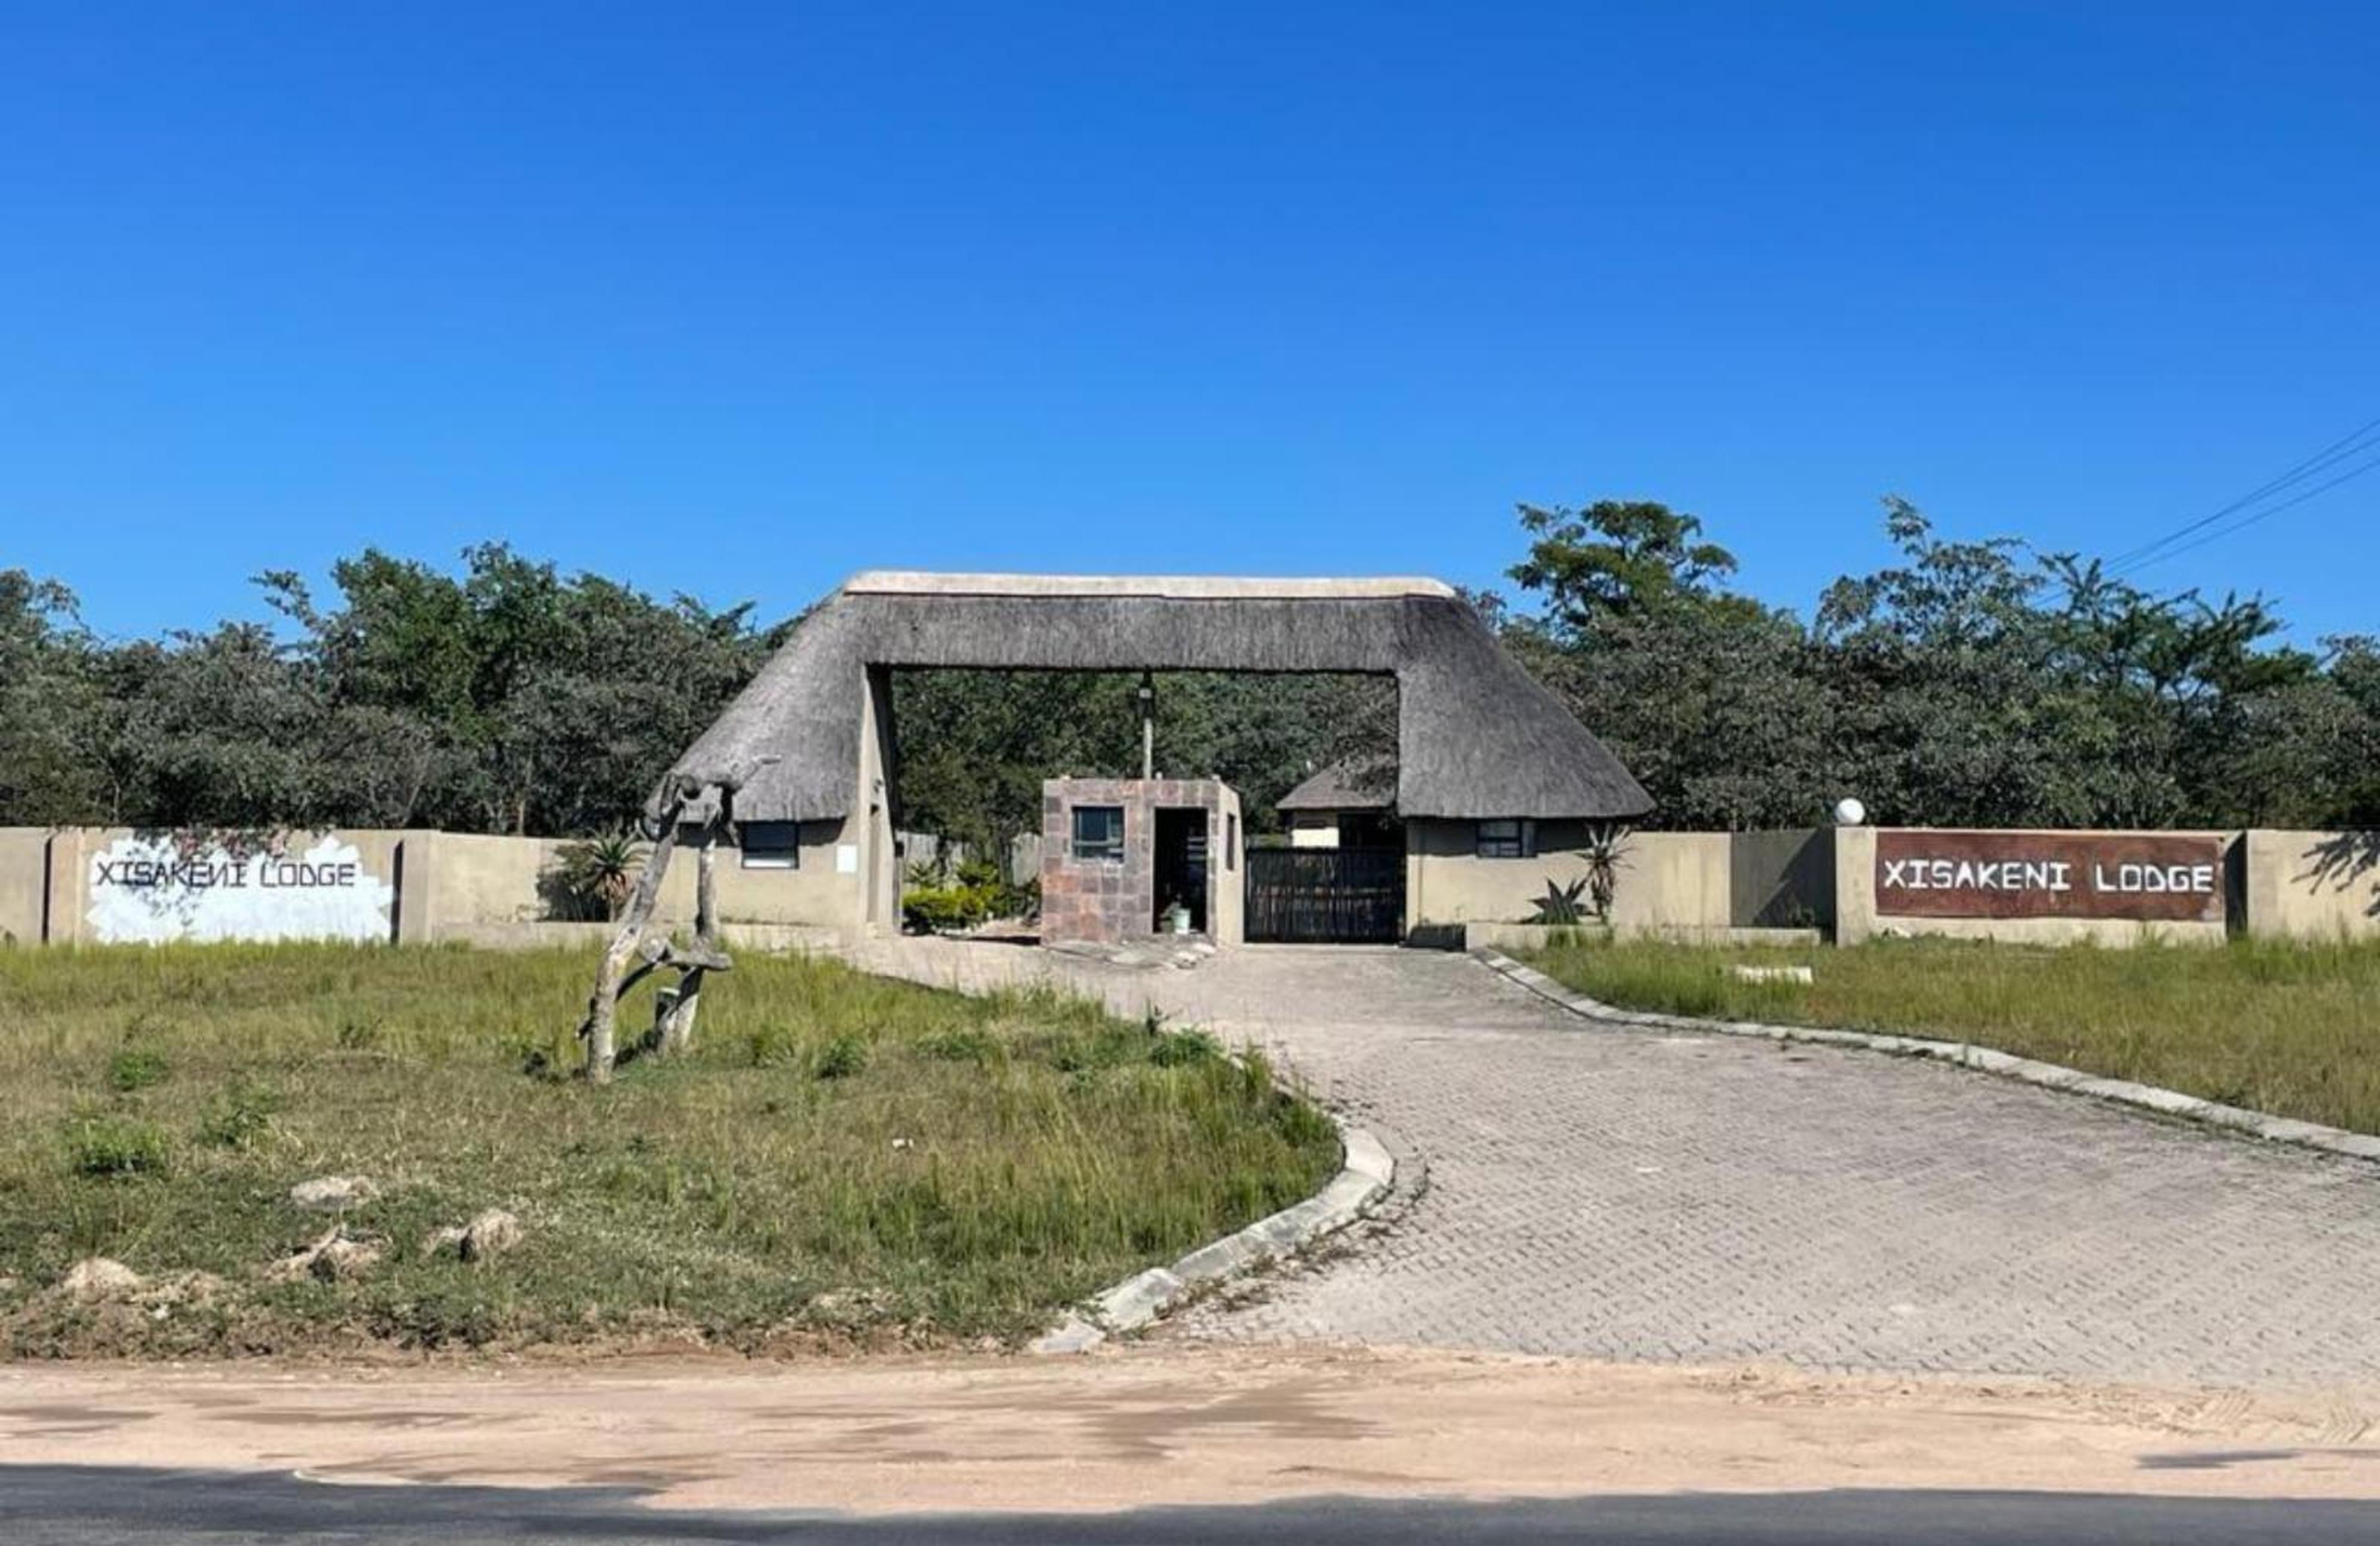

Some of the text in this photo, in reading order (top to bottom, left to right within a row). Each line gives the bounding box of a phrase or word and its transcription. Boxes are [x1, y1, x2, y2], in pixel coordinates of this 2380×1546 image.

[97, 861, 355, 888] XISAKENI LODGE
[1884, 860, 2213, 892] XISAKENI LODGE
